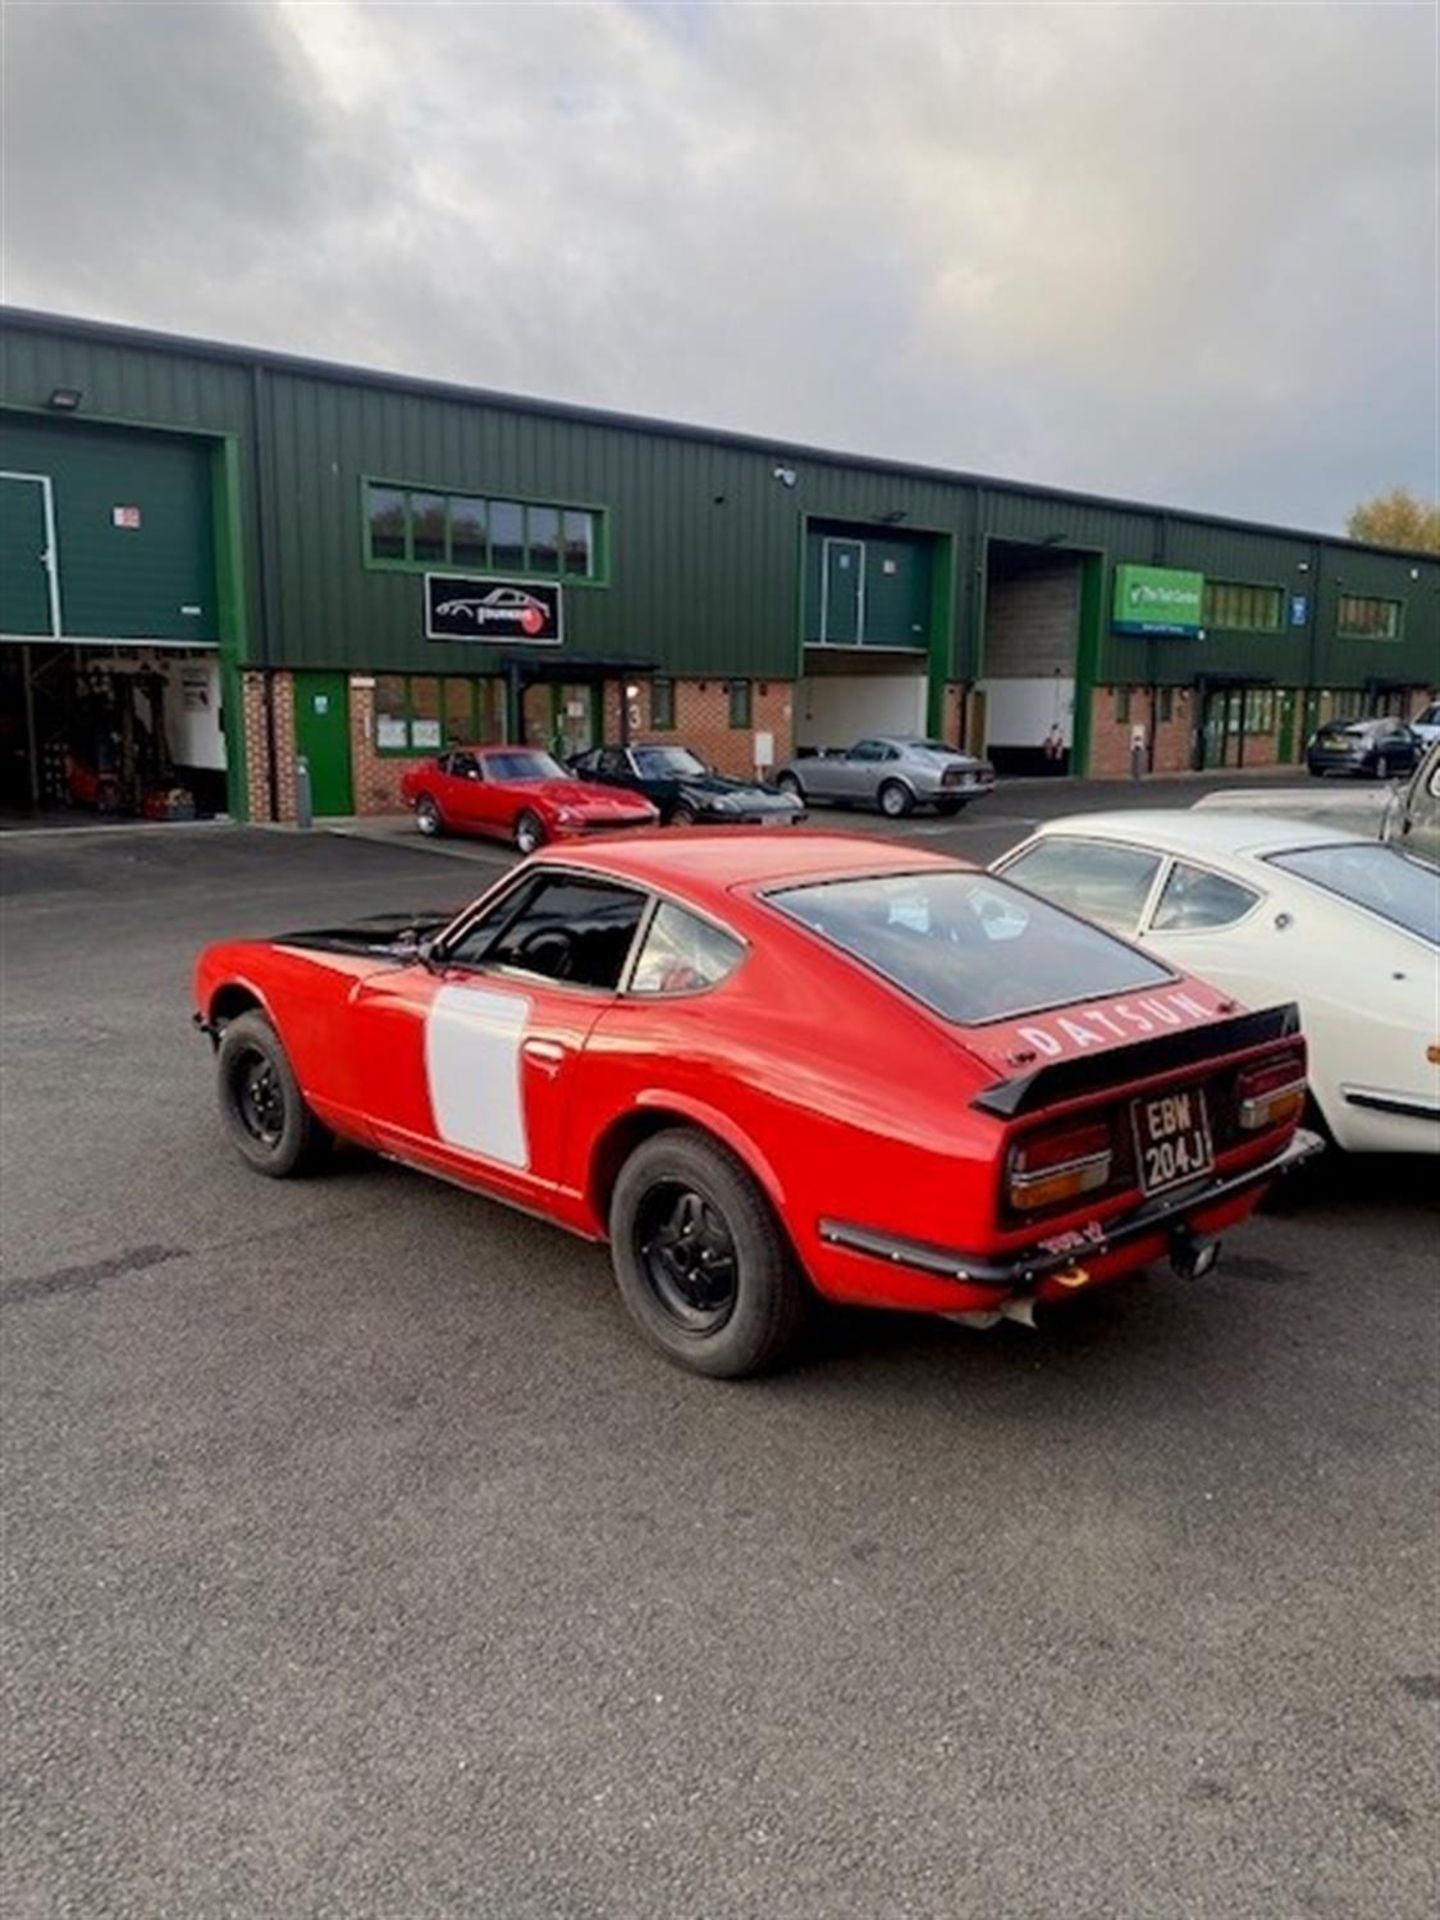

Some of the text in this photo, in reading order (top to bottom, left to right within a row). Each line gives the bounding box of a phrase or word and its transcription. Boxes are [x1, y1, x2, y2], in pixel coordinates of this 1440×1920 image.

[1016, 991, 1214, 1056] DATSUN
[1146, 1092, 1191, 1141] EBW
[1145, 1130, 1205, 1186] 204J
